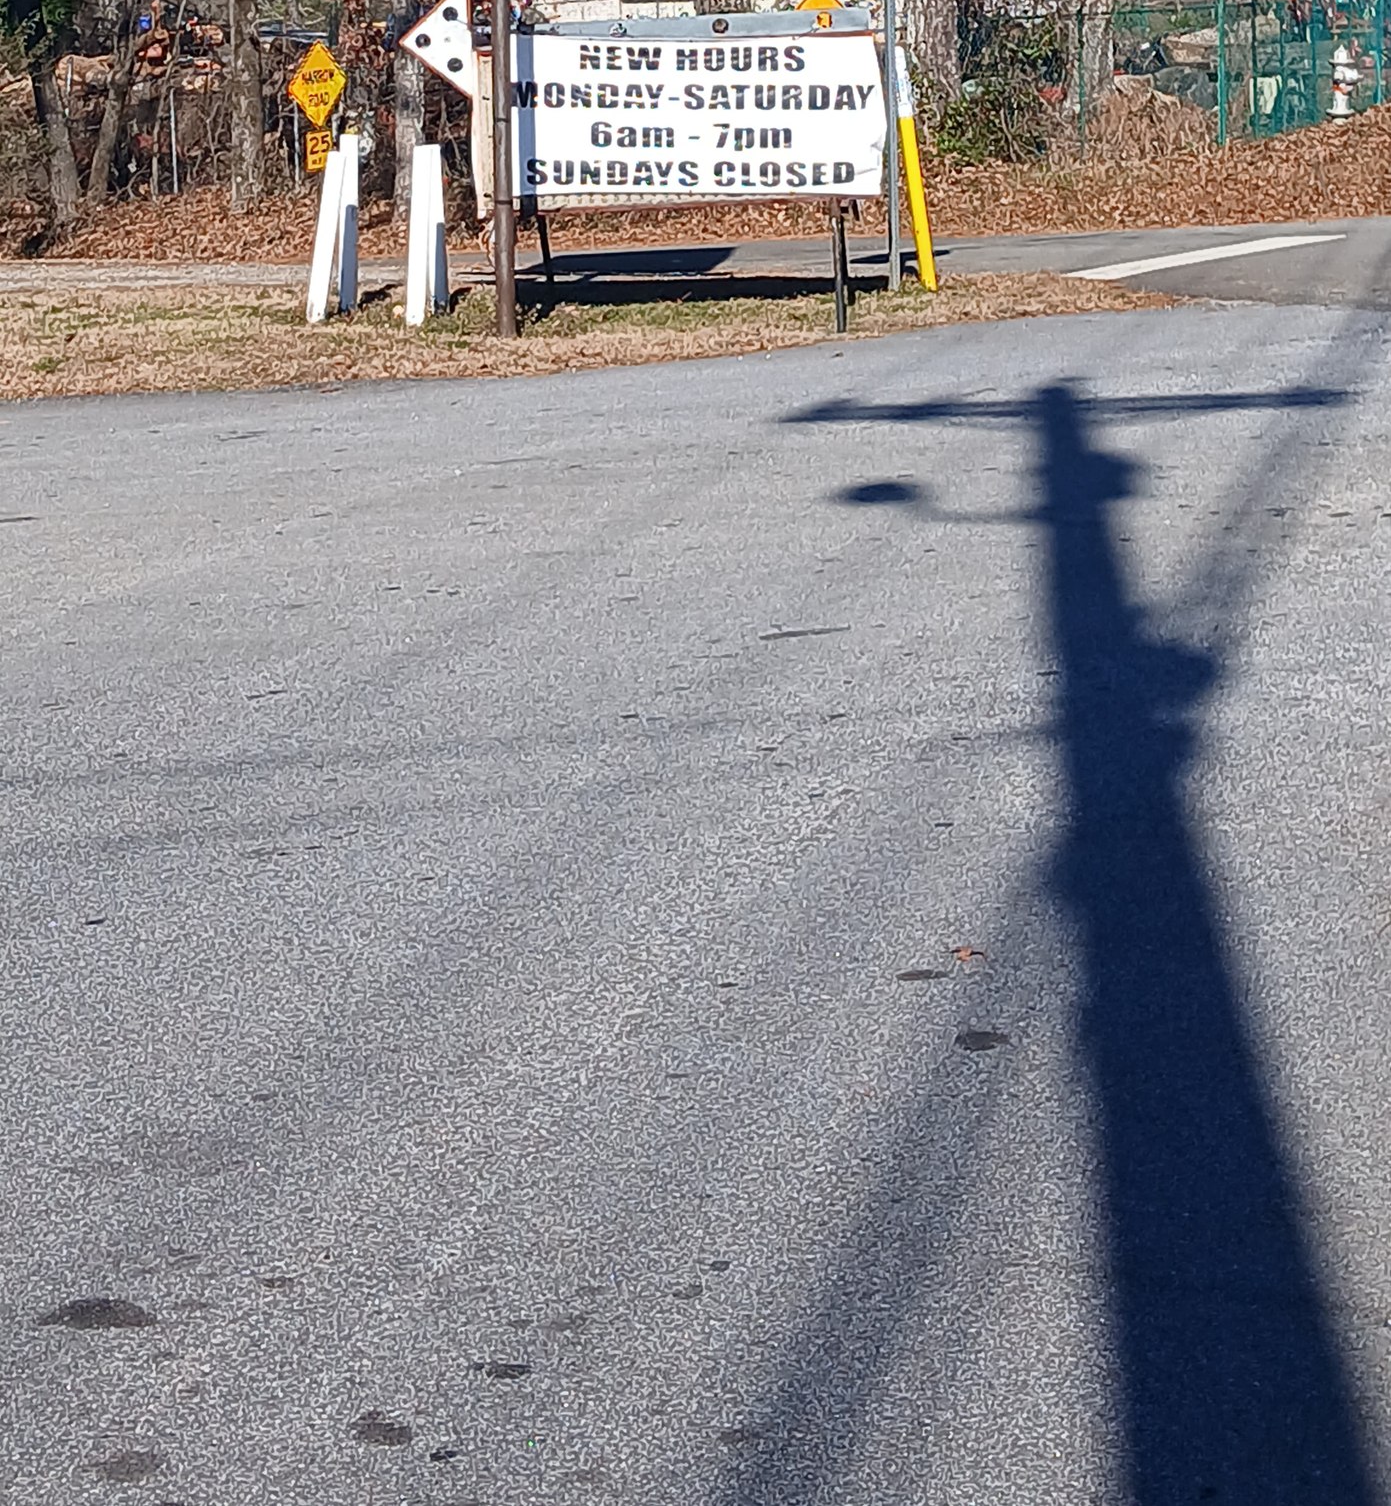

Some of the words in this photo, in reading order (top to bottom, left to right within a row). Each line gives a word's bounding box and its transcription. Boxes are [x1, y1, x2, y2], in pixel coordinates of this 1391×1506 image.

[579, 45, 662, 71] NEW
[676, 45, 806, 72] HOURS
[310, 135, 330, 155] 25
[590, 121, 675, 148] 6am
[713, 123, 792, 151] 7pm
[526, 159, 700, 186] SUNDAYS
[714, 160, 856, 186] CLOSED
